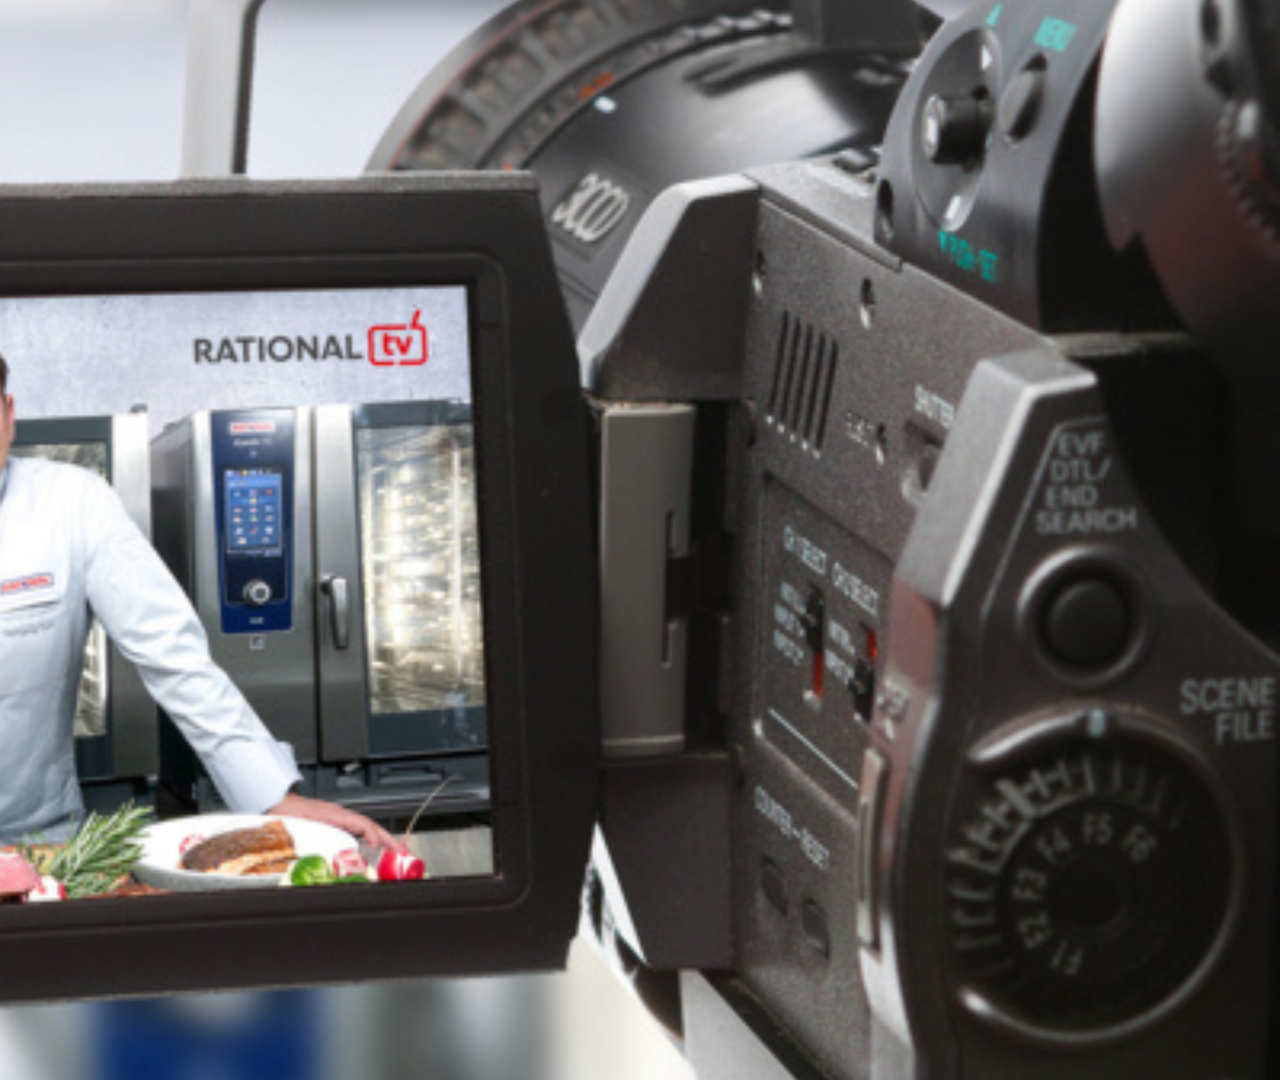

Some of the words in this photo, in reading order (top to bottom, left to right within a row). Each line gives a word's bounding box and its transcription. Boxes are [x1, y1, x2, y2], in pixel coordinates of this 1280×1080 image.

[193, 334, 363, 364] RATIONAL
[382, 332, 413, 356] tv
[1057, 432, 1105, 456] EVF
[1050, 456, 1112, 482] DTL/
[1045, 486, 1099, 509] END
[1036, 506, 1138, 535] SEARCH
[1180, 678, 1276, 715] SCENE
[1215, 710, 1275, 745] FILE
[1036, 826, 1072, 866] F4
[1083, 811, 1114, 846] F5
[1121, 823, 1158, 864] F6
[1012, 868, 1048, 901] F3
[1016, 912, 1053, 950] F2
[1051, 941, 1085, 976] F1
